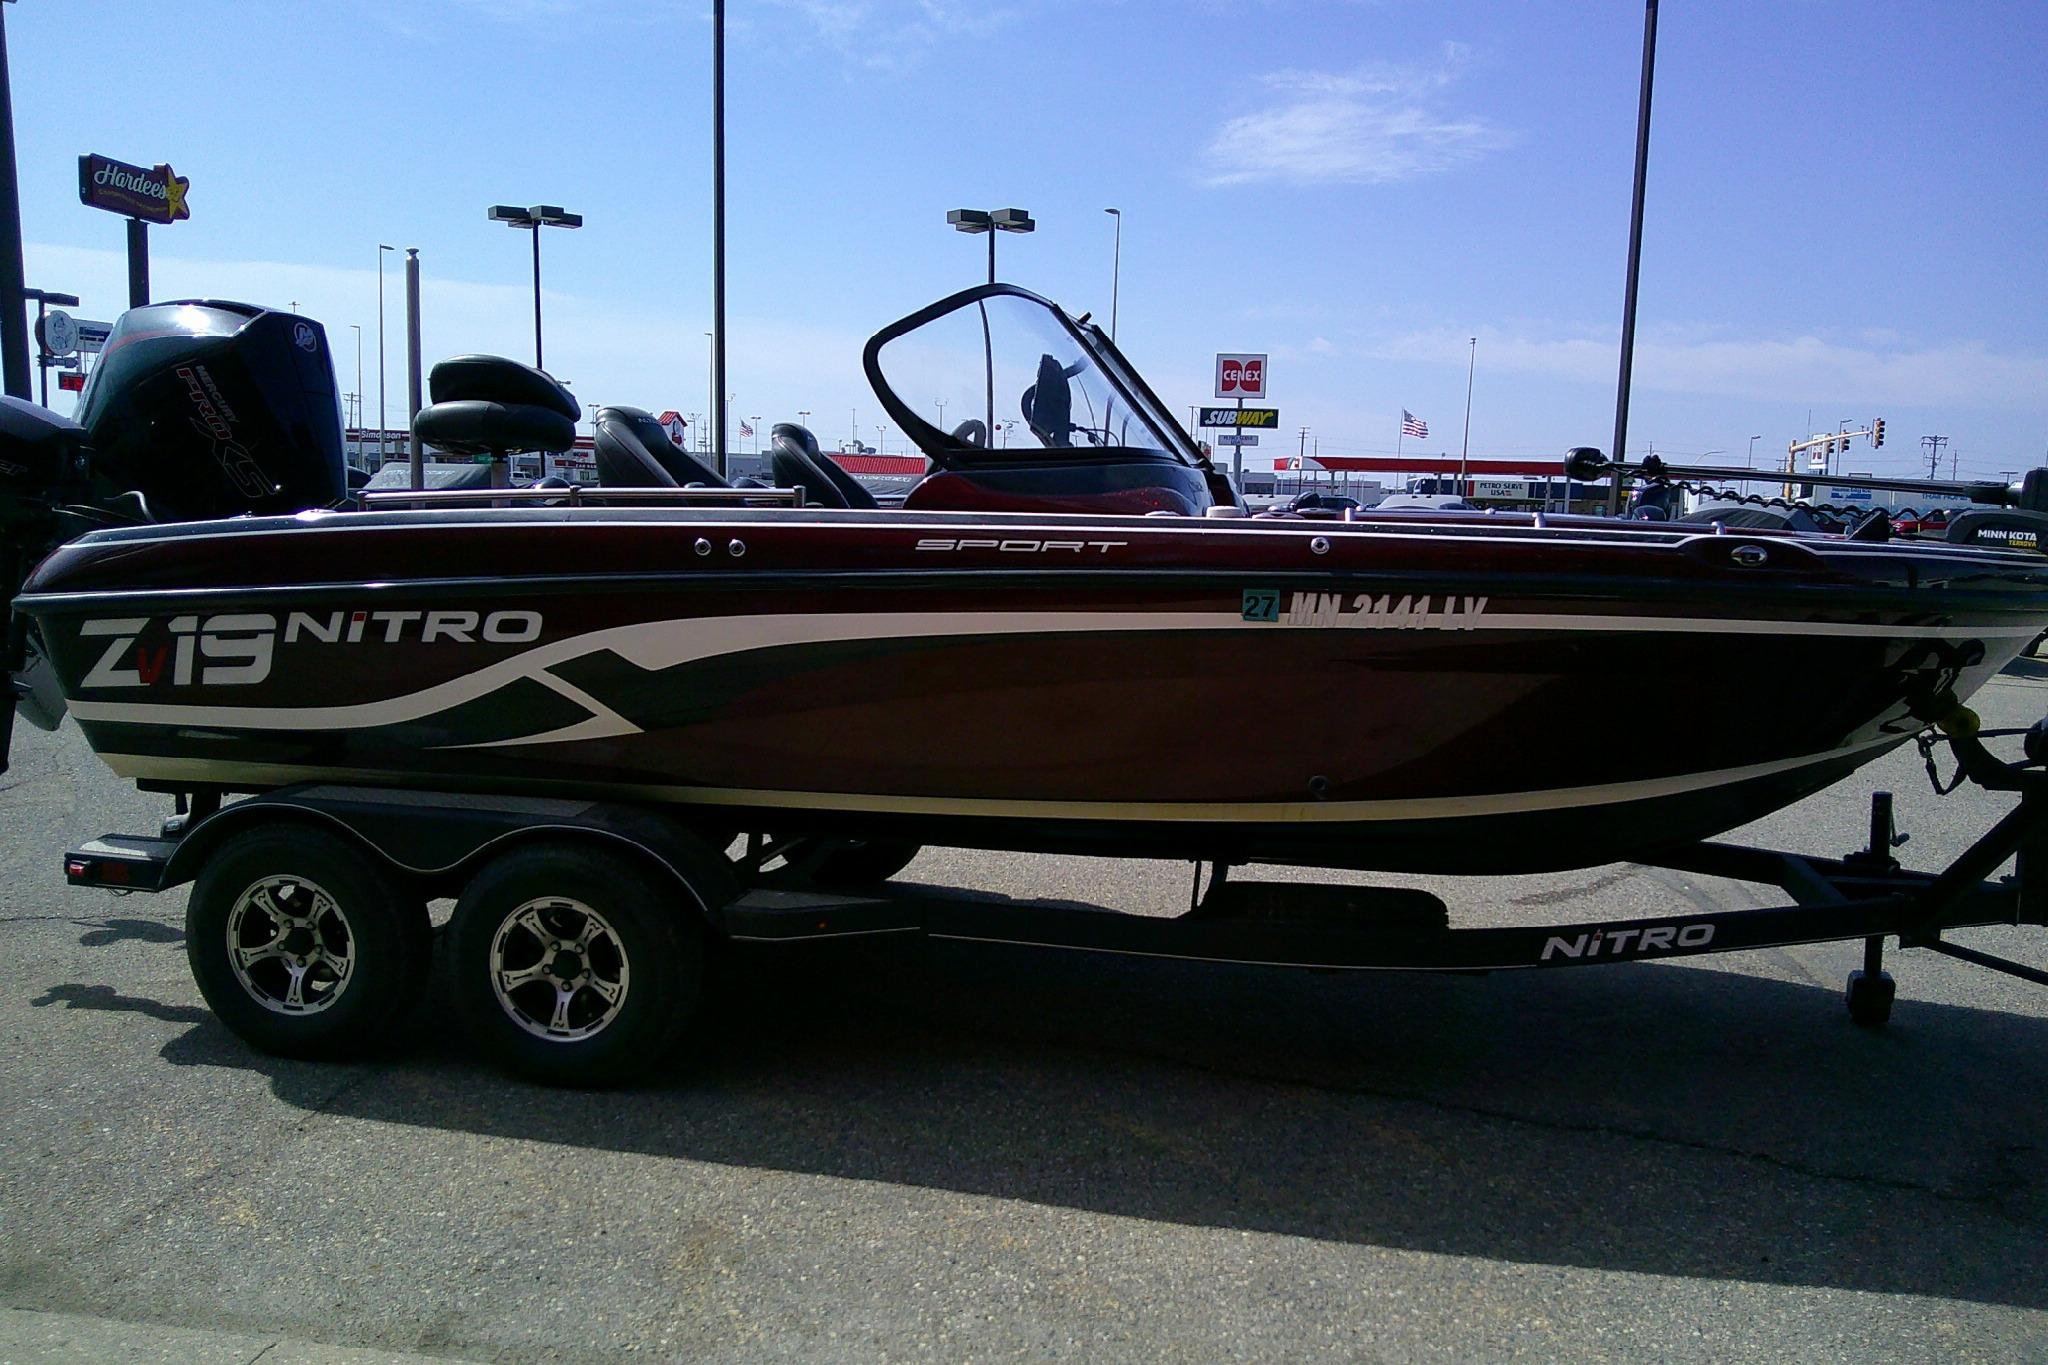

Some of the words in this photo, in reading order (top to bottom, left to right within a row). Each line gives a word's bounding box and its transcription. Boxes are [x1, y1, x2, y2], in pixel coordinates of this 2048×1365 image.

[94, 163, 167, 199] Hardee's
[1223, 369, 1261, 382] CENEX
[1205, 410, 1274, 425] SUBWAY
[361, 430, 401, 439] Simoson
[1977, 529, 2007, 539] MINN
[2009, 531, 2037, 541] KOTA
[915, 539, 1128, 553] SPORT
[1244, 596, 1276, 618] 27
[1288, 592, 1342, 627] MN
[1440, 596, 1488, 630] LV
